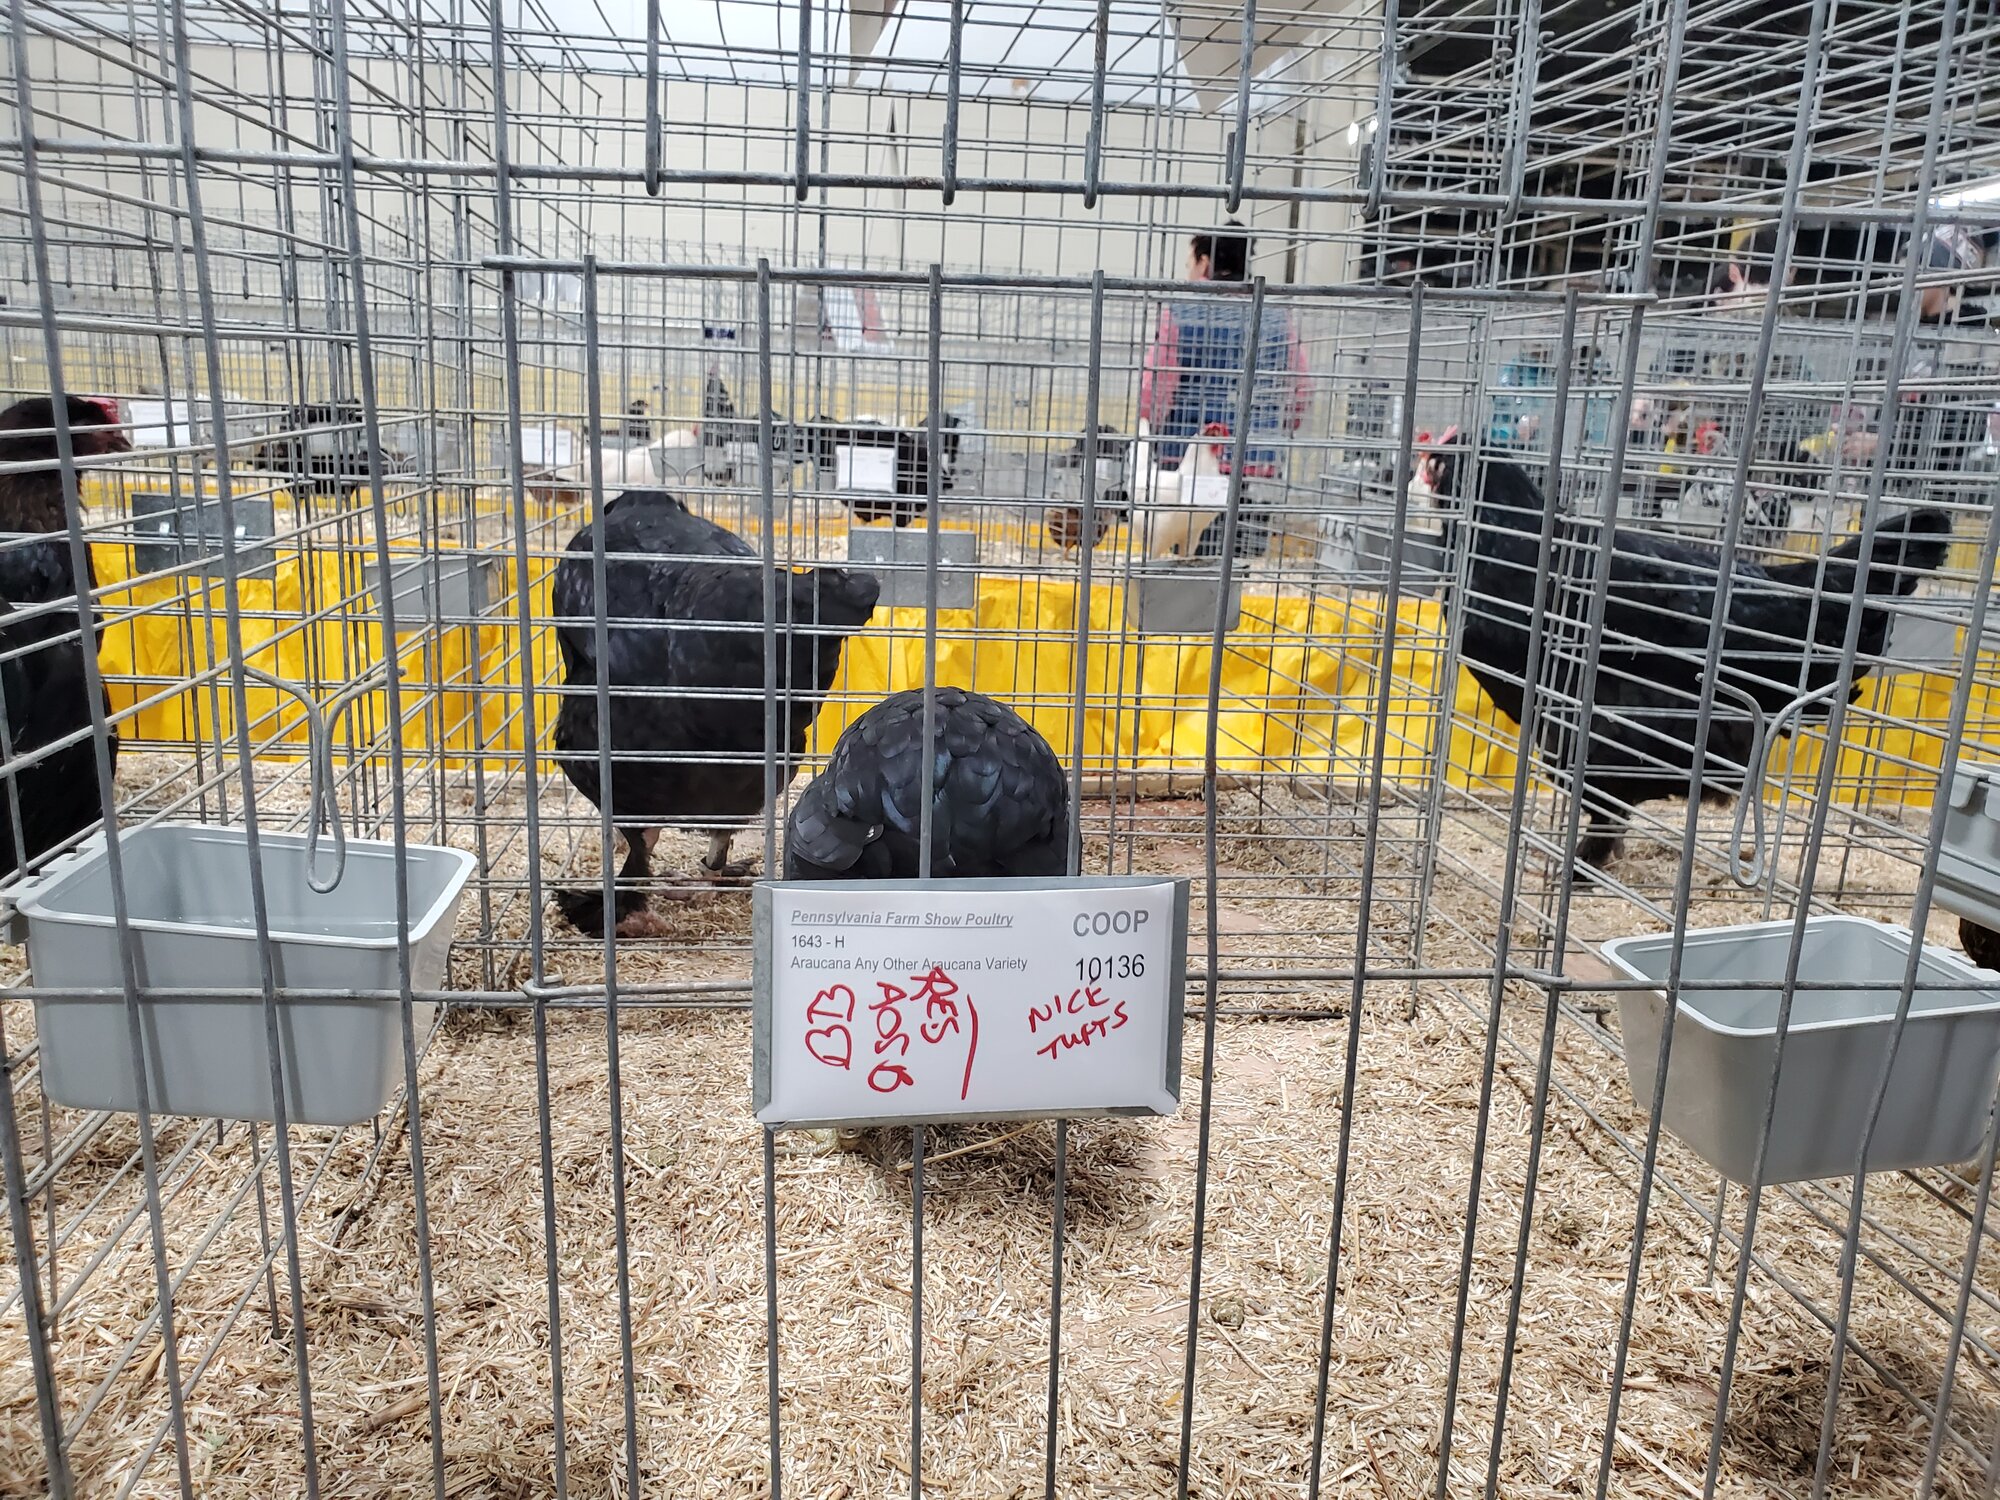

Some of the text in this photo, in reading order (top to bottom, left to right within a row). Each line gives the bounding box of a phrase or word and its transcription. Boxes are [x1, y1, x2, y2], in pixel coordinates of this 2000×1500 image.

[791, 910, 1014, 927] Pennsylvania Farm Show Poultry
[1073, 910, 1149, 937] COOP
[791, 934, 823, 948] 1643
[835, 935, 845, 948] H
[790, 956, 1028, 973] Araucana Any Other Araucana Variety
[1075, 953, 1145, 981] 10136
[1028, 986, 1110, 1033] NICE
[1037, 1000, 1129, 1060] TUFTS
